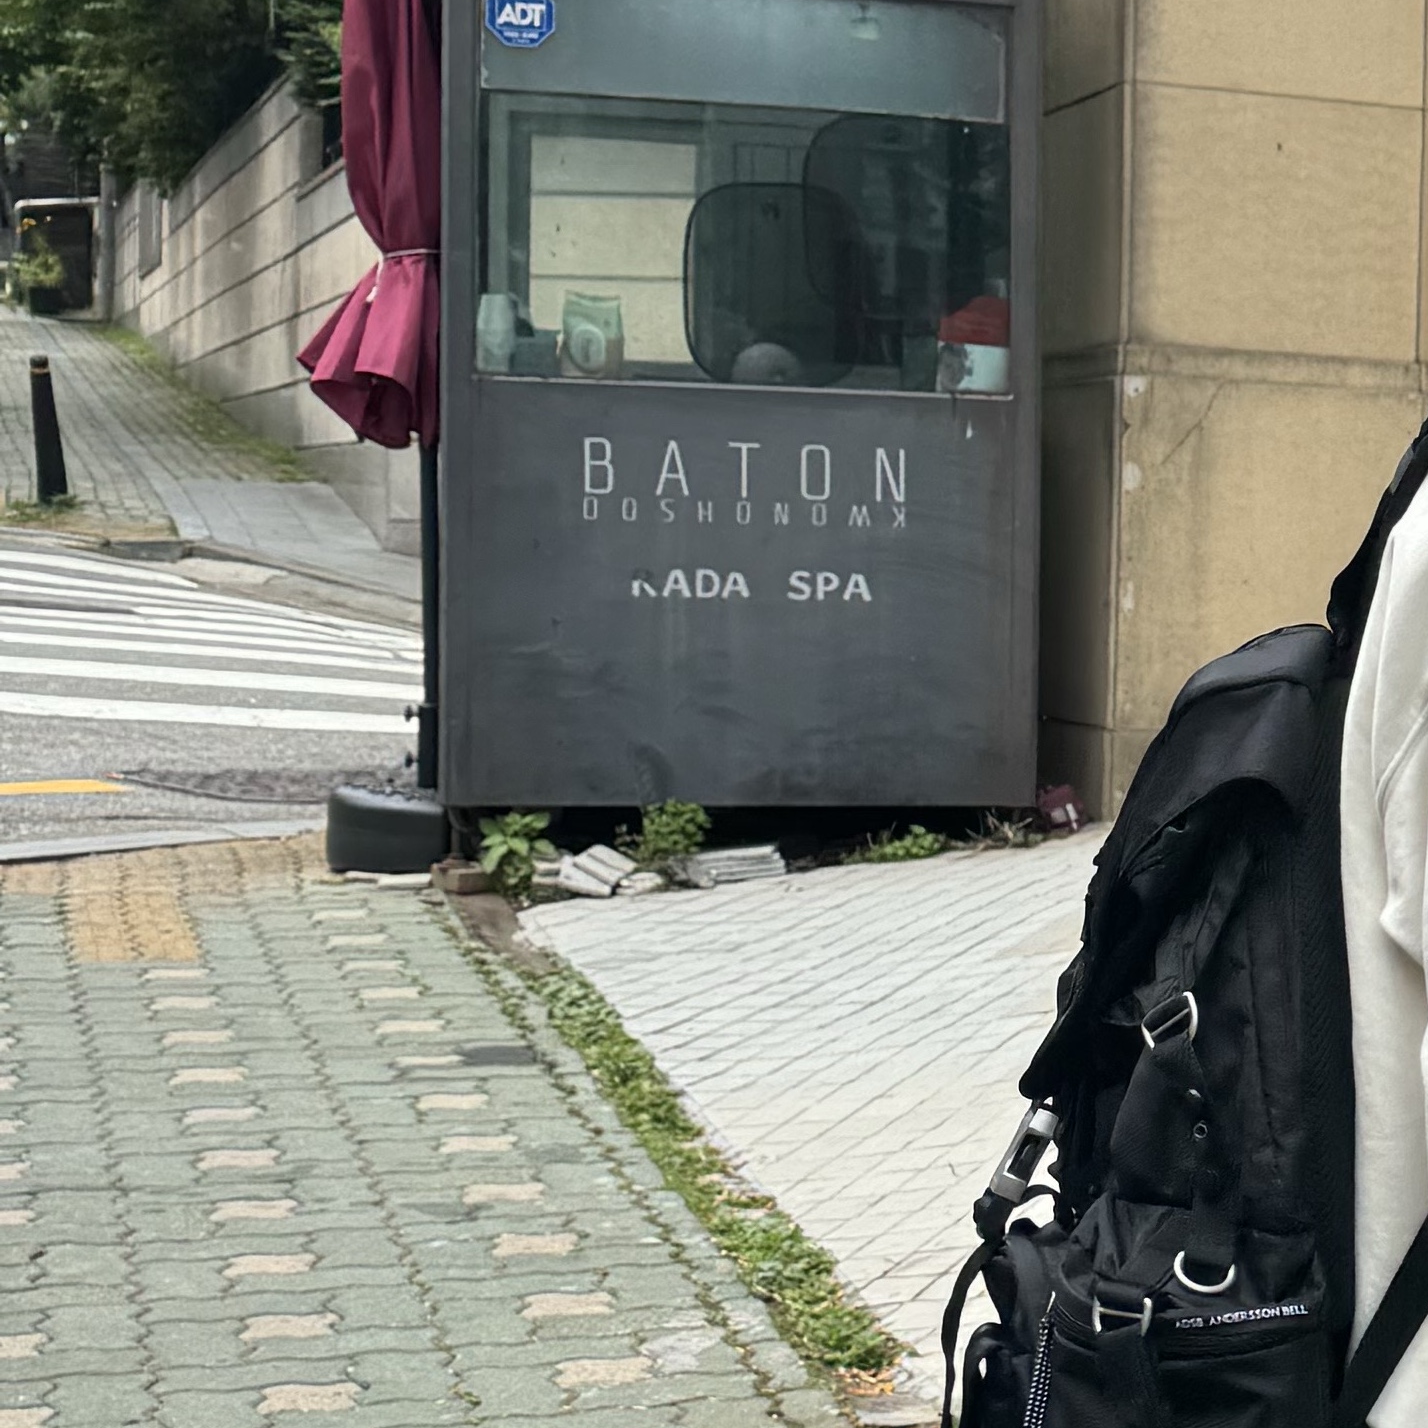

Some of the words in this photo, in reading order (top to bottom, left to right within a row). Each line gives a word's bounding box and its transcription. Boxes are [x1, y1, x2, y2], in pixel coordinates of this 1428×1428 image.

[496, 1, 546, 27] ADT
[583, 436, 905, 503] BATON
[786, 570, 872, 602] SPA
[1281, 1304, 1309, 1316] BELL
